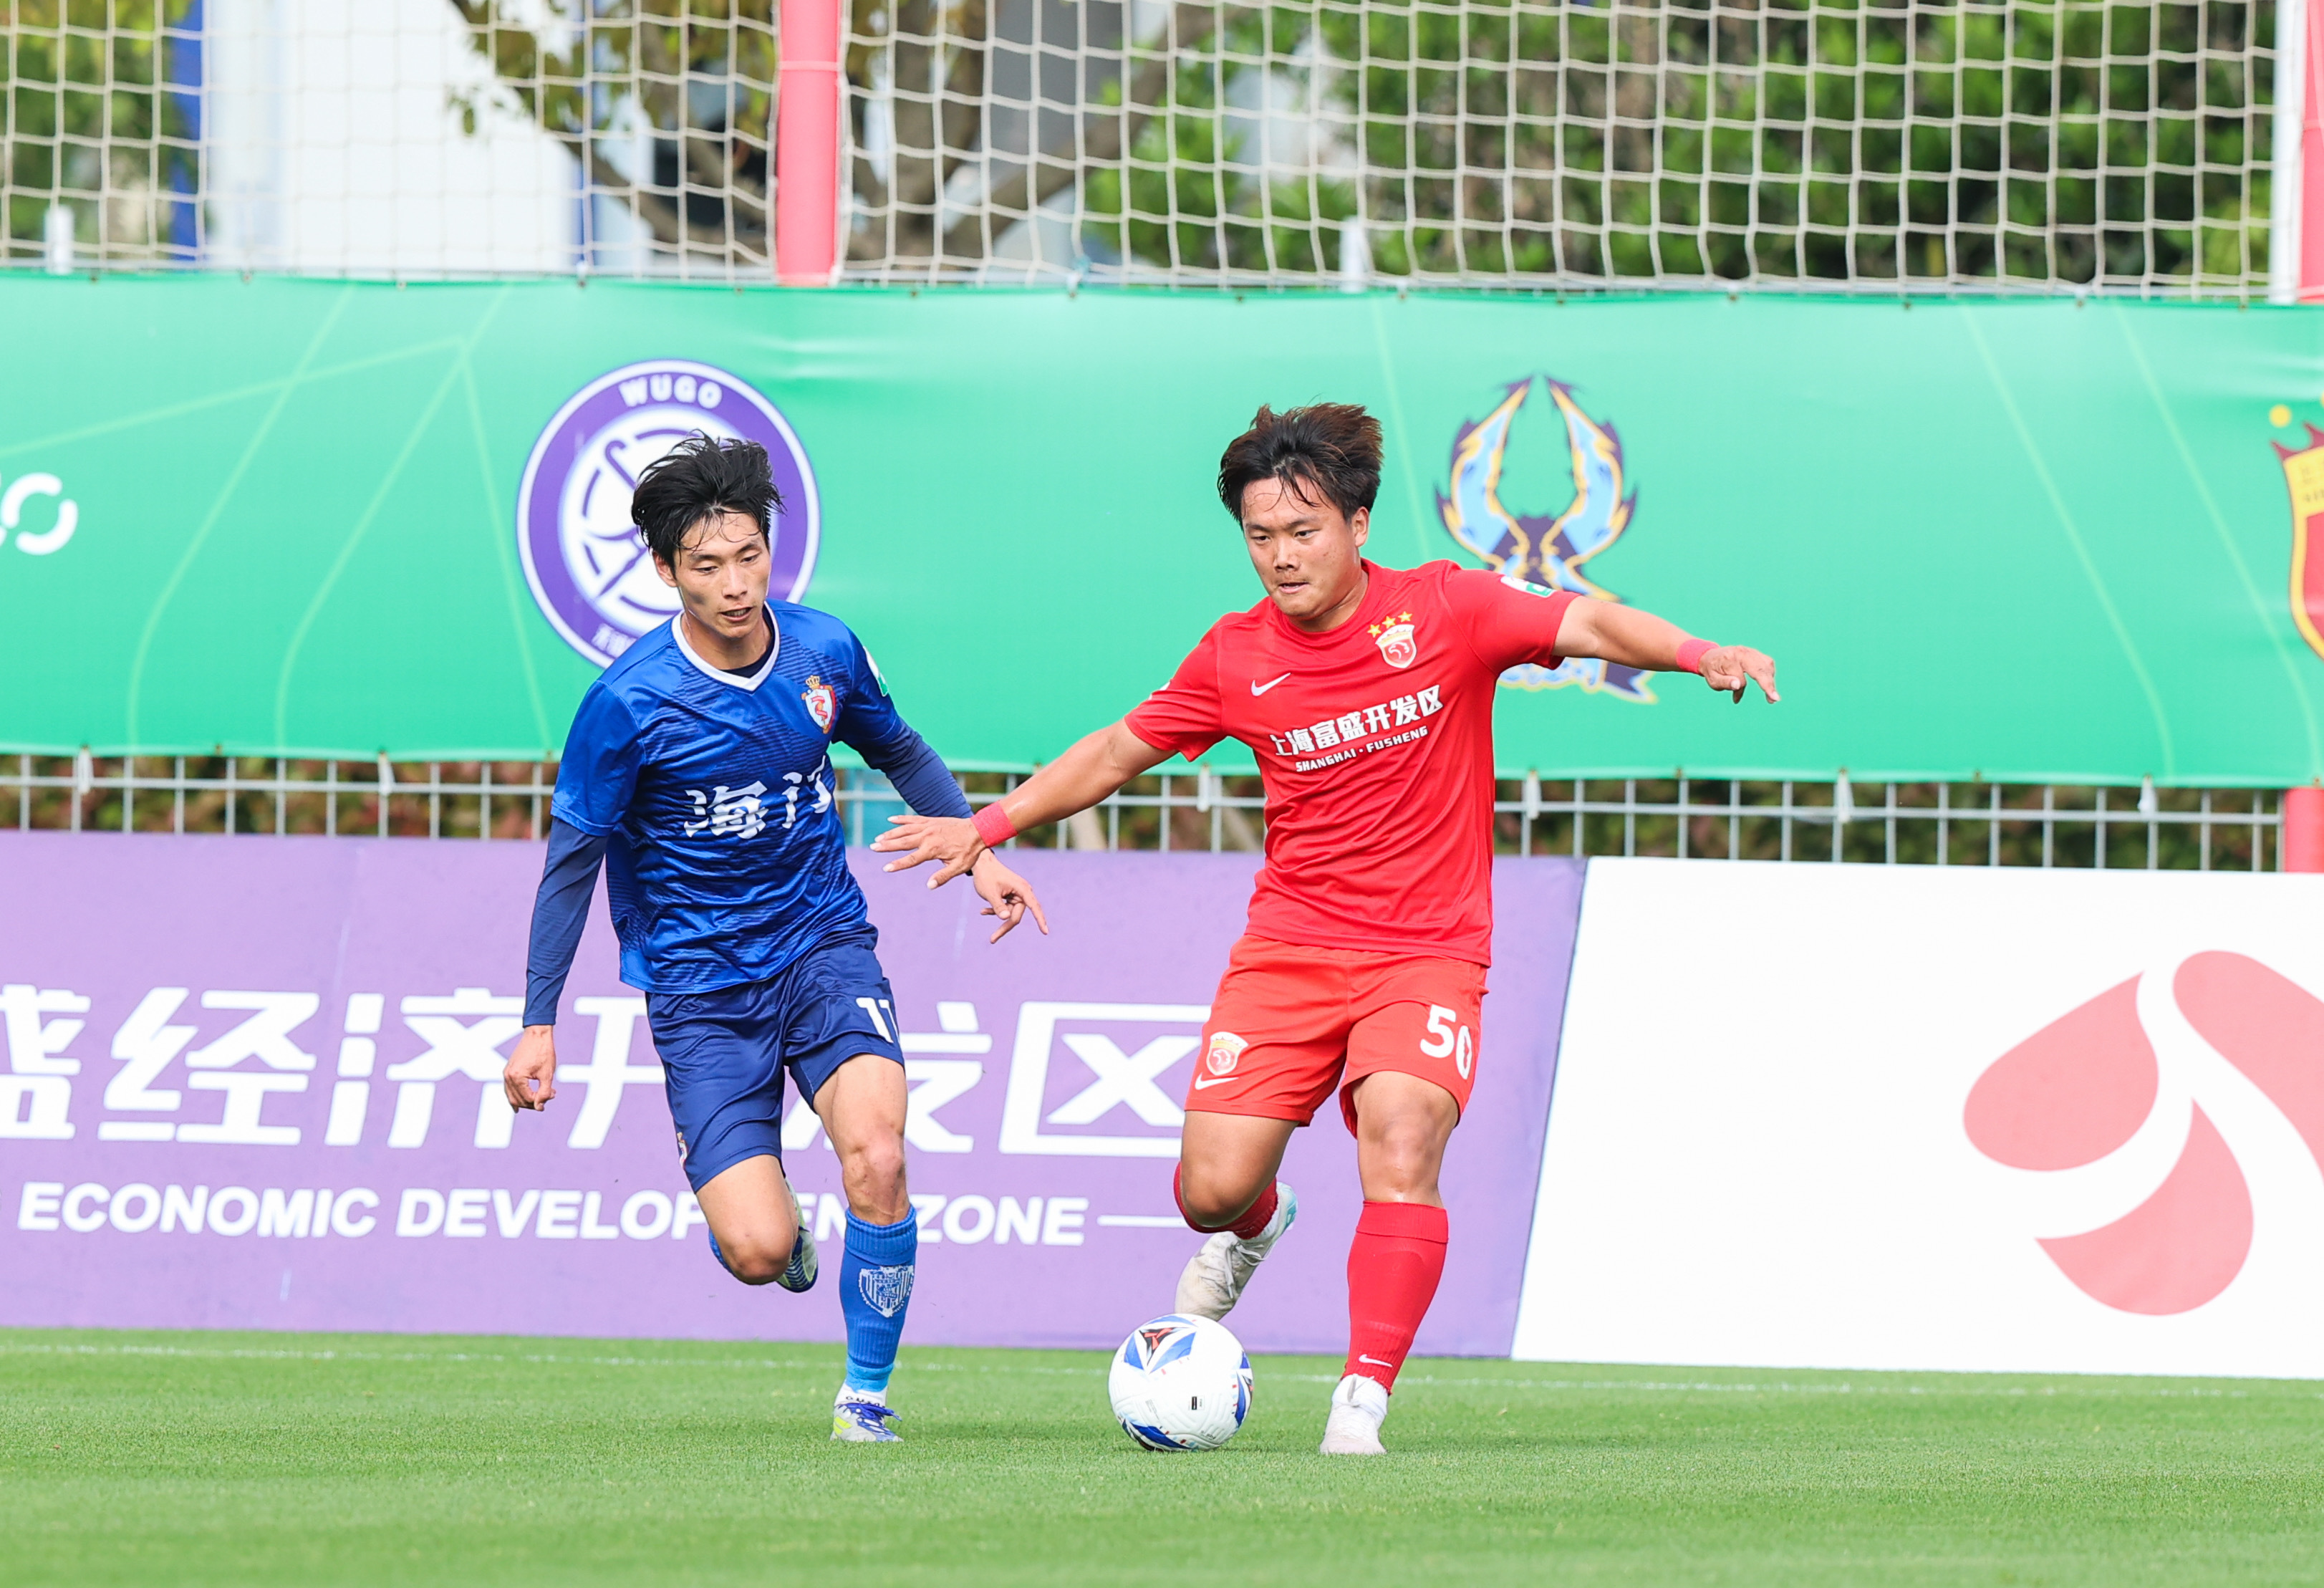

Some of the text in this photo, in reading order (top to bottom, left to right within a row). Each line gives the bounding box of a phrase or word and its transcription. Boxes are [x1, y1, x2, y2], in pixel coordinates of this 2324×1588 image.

[1270, 684, 1444, 756] 上海富盛开发区
[1295, 726, 1429, 772] SHANGHAI FUSHENG
[1420, 1004, 1472, 1079] 50
[17, 1182, 1089, 1246] ECONOMIC DEVELOPEN ZONE
